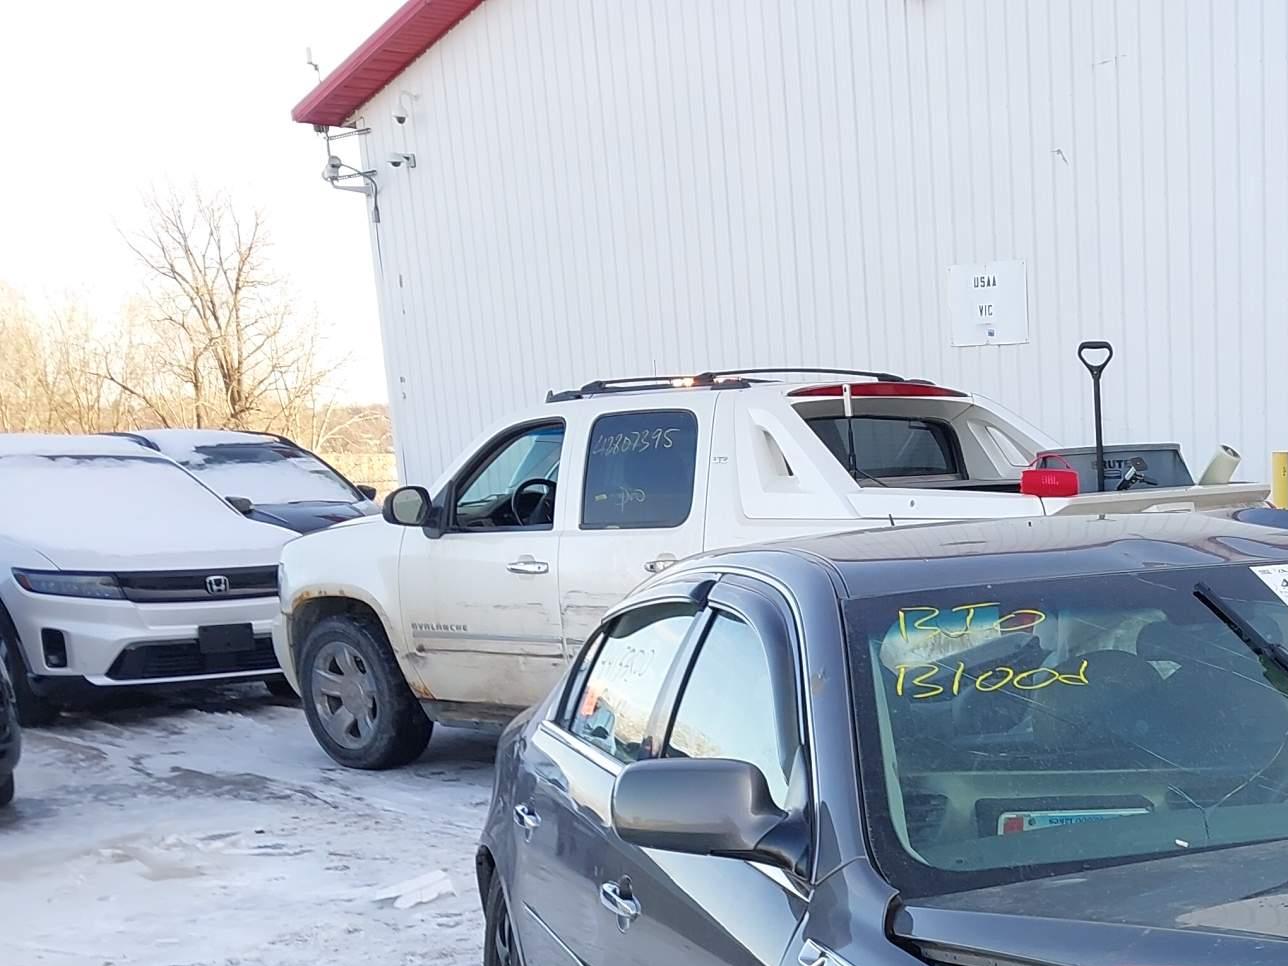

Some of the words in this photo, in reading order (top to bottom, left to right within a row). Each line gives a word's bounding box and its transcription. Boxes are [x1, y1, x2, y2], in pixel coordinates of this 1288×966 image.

[973, 275, 997, 288] USAA
[979, 304, 993, 317] VIC
[896, 659, 1089, 699] Blood
